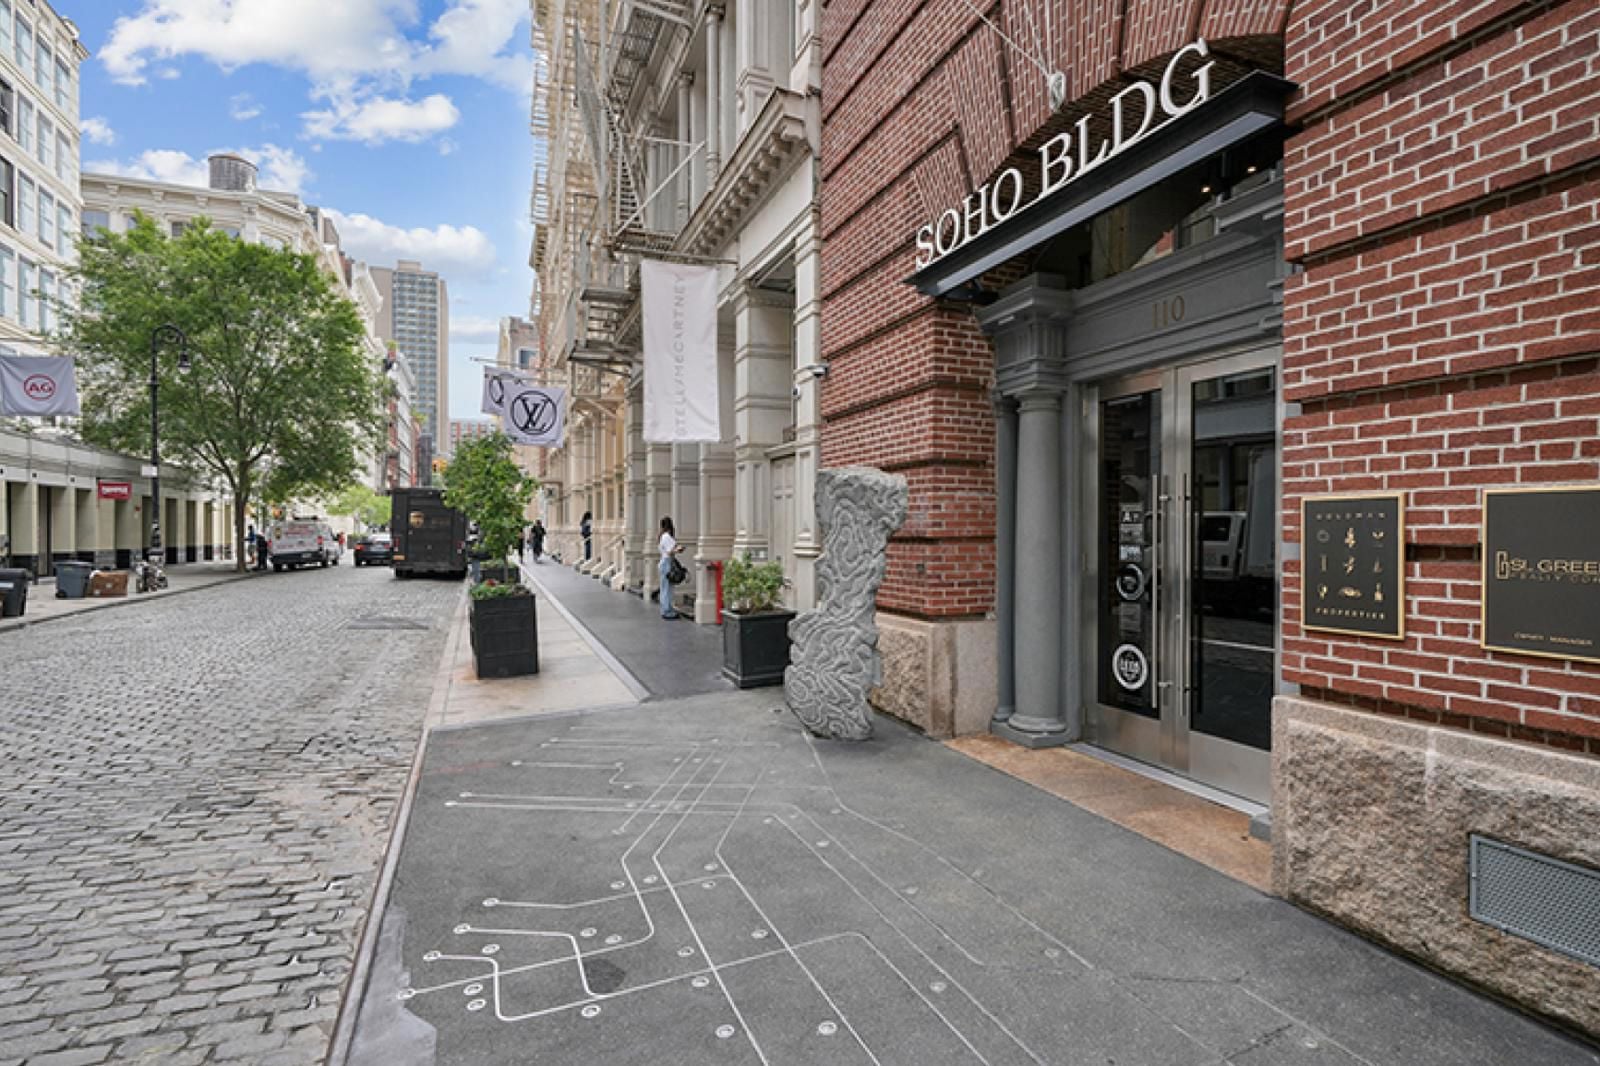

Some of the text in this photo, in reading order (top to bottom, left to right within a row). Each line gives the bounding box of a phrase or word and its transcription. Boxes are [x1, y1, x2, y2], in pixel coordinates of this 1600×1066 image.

[915, 37, 1216, 271] SOHO BLDG
[1151, 295, 1185, 329] 110
[1537, 559, 1600, 575] GREE
